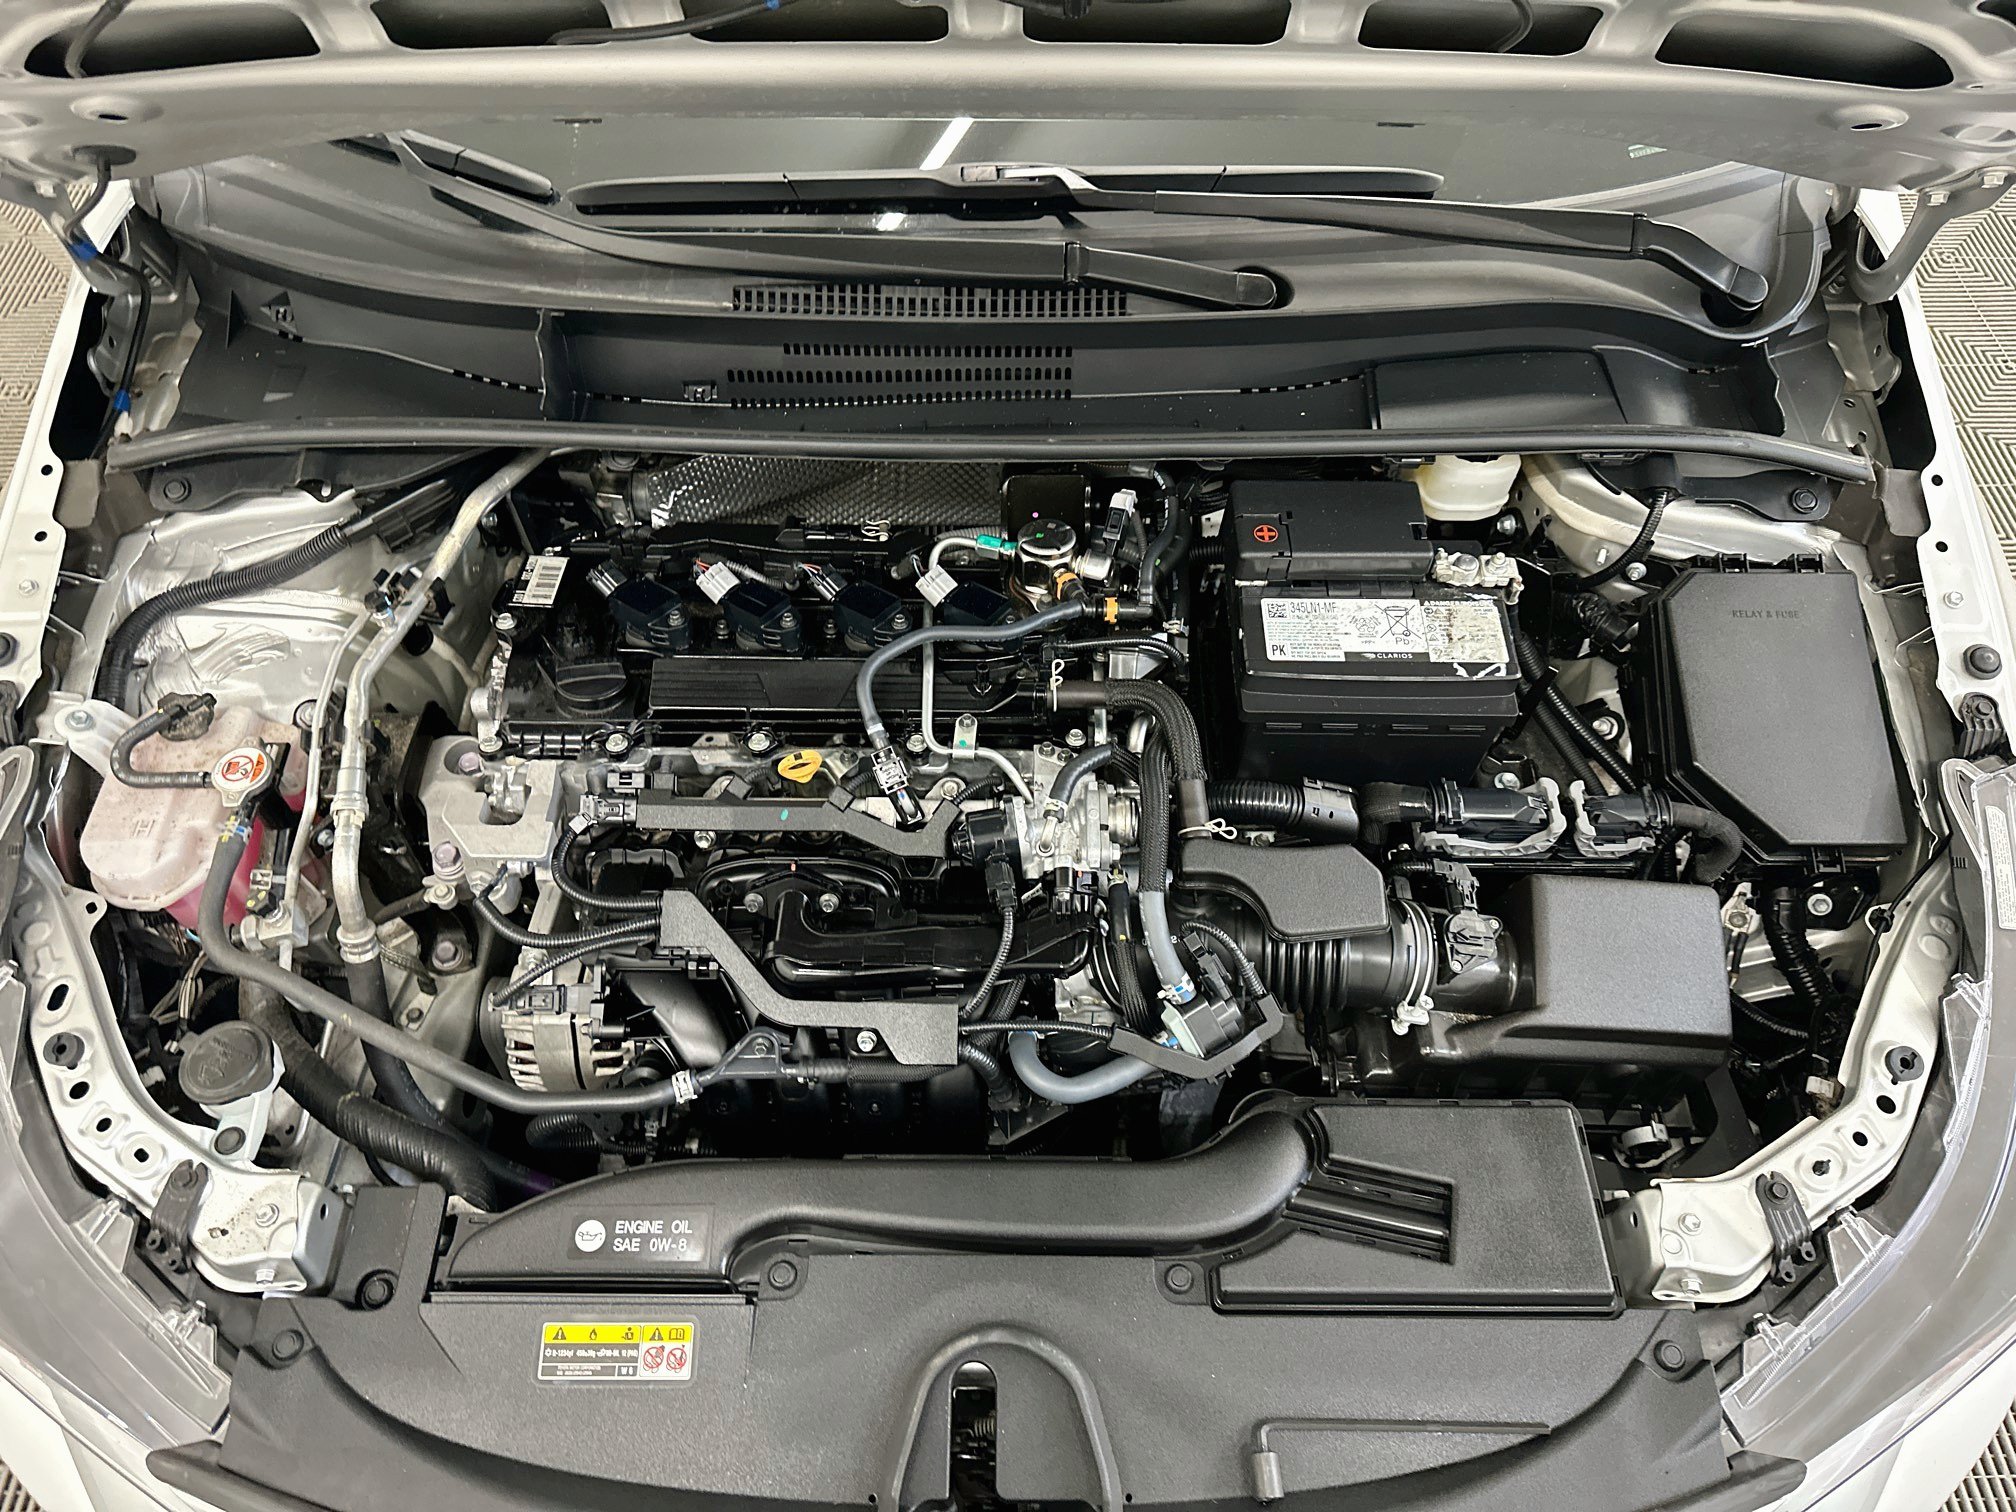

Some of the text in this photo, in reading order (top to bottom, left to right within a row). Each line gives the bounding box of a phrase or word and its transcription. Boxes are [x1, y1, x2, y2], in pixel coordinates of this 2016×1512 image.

[1732, 609, 1763, 618] RELAY
[1395, 636, 1410, 645] Pb
[1271, 644, 1286, 656] PK
[614, 1219, 693, 1235] ENGINE OIL
[612, 1237, 688, 1252] SAE 0W-8
